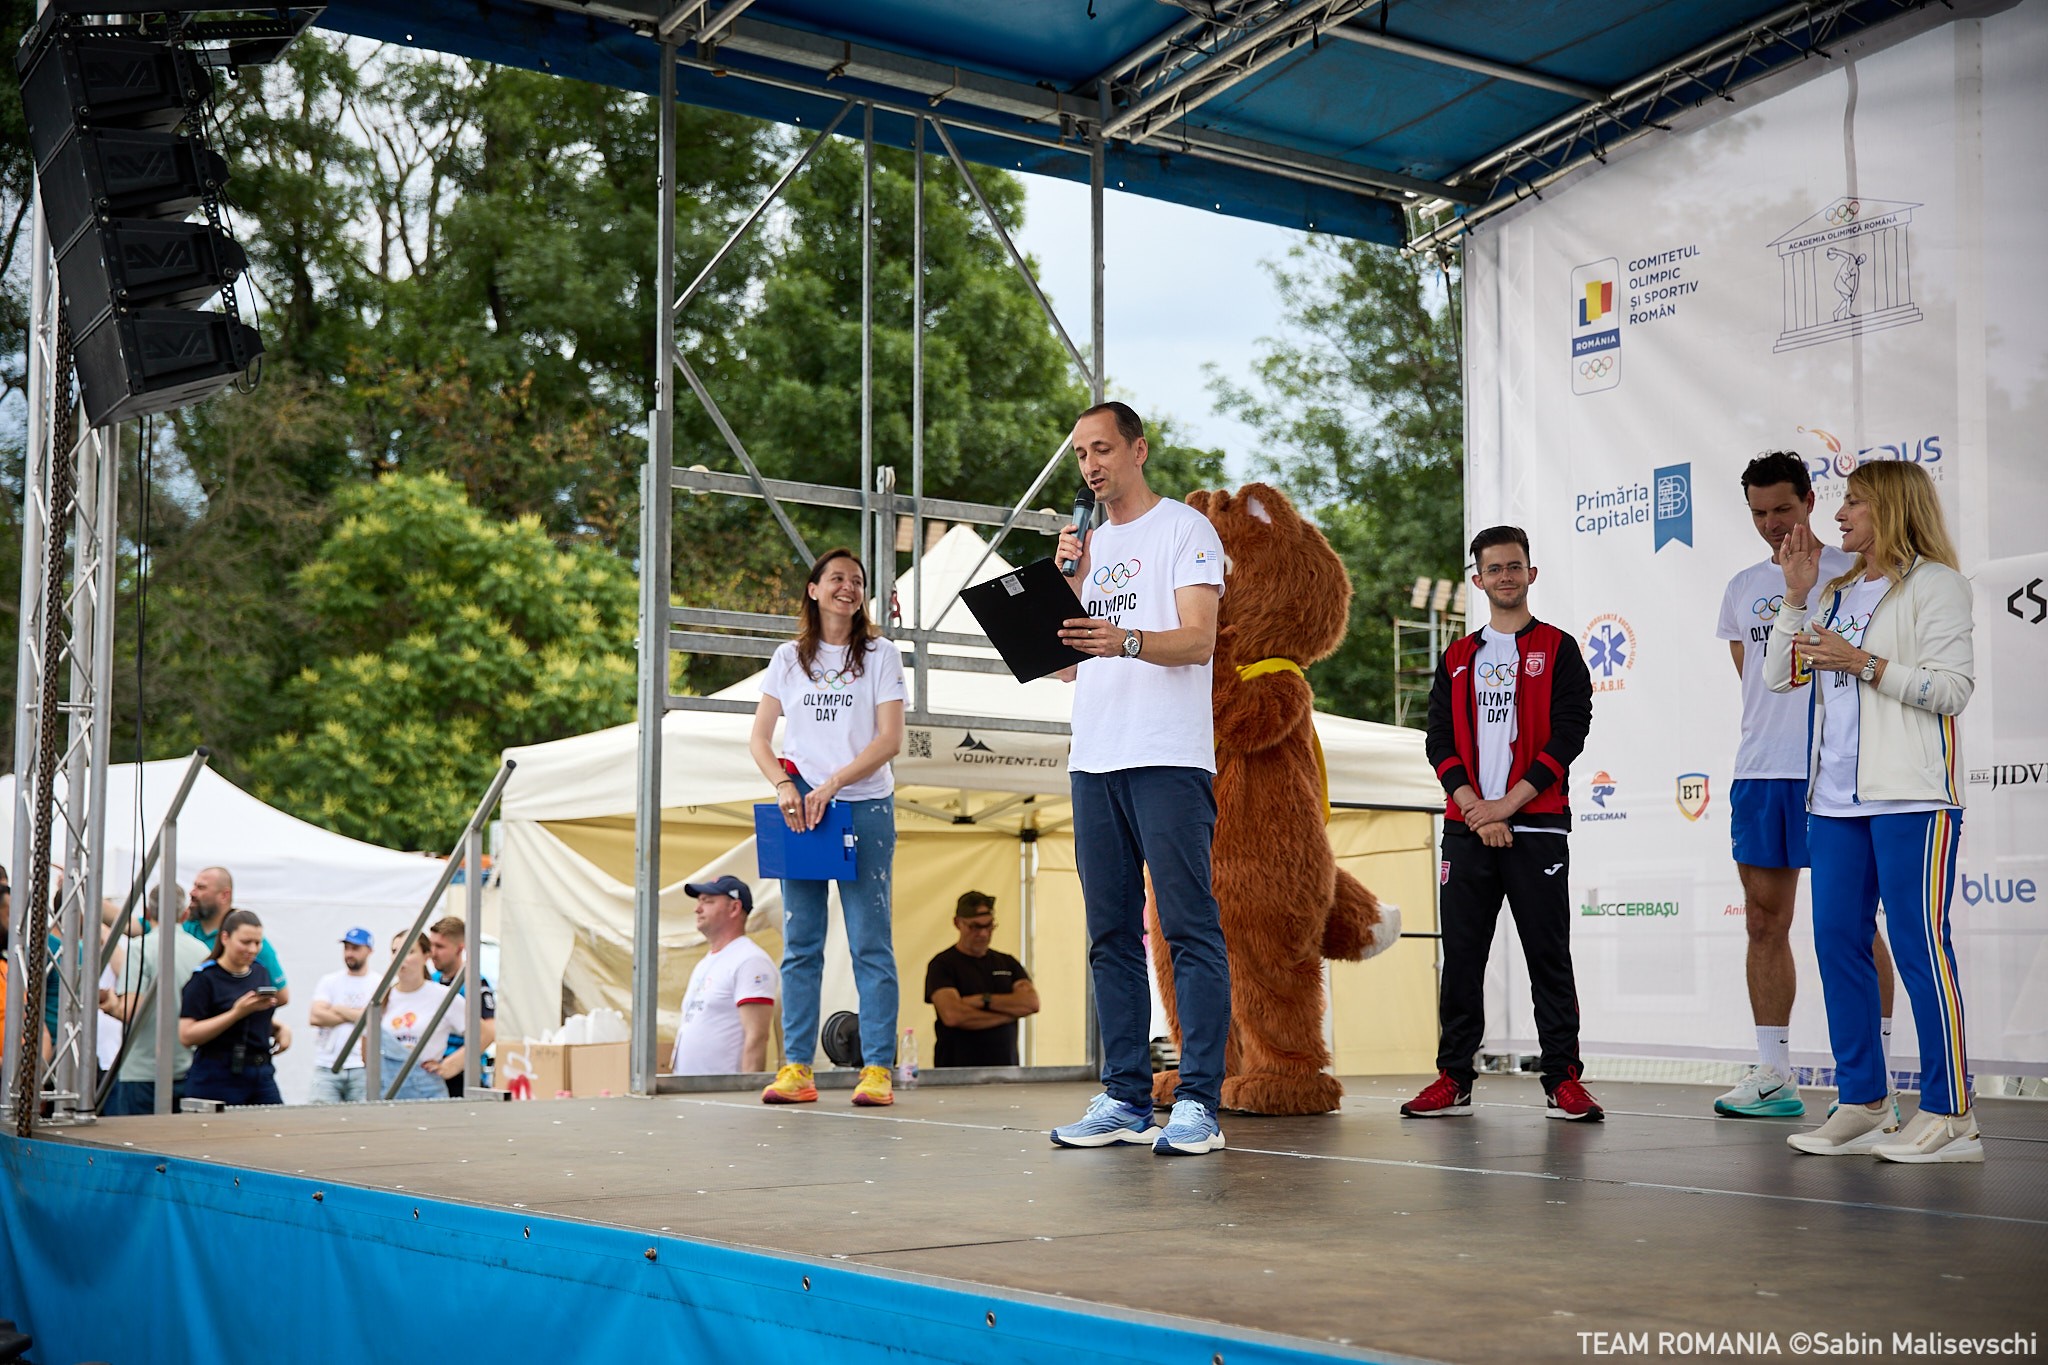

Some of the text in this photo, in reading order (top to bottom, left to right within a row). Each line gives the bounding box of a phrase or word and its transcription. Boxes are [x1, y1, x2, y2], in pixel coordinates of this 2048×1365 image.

[1788, 235, 1826, 250] ACADEMIA
[1628, 245, 1700, 272] COMITETUL
[1629, 267, 1681, 289] OLIMPIC
[1644, 280, 1699, 304] SPORTIV
[1629, 304, 1676, 325] ROMÂN
[1576, 335, 1617, 351] ROMÂNIA
[1577, 483, 1648, 511] Primăria
[1575, 503, 1649, 535] Capitalei
[803, 693, 853, 707] OLYMPIC
[815, 708, 838, 722] DAY
[1487, 708, 1509, 723] DAY
[953, 752, 1058, 768] VOUWTENT.EU
[1991, 762, 2048, 792] JIDV
[1683, 785, 1703, 800] BT
[1581, 812, 1627, 822] DEDEMAN
[1962, 873, 2037, 906] blue
